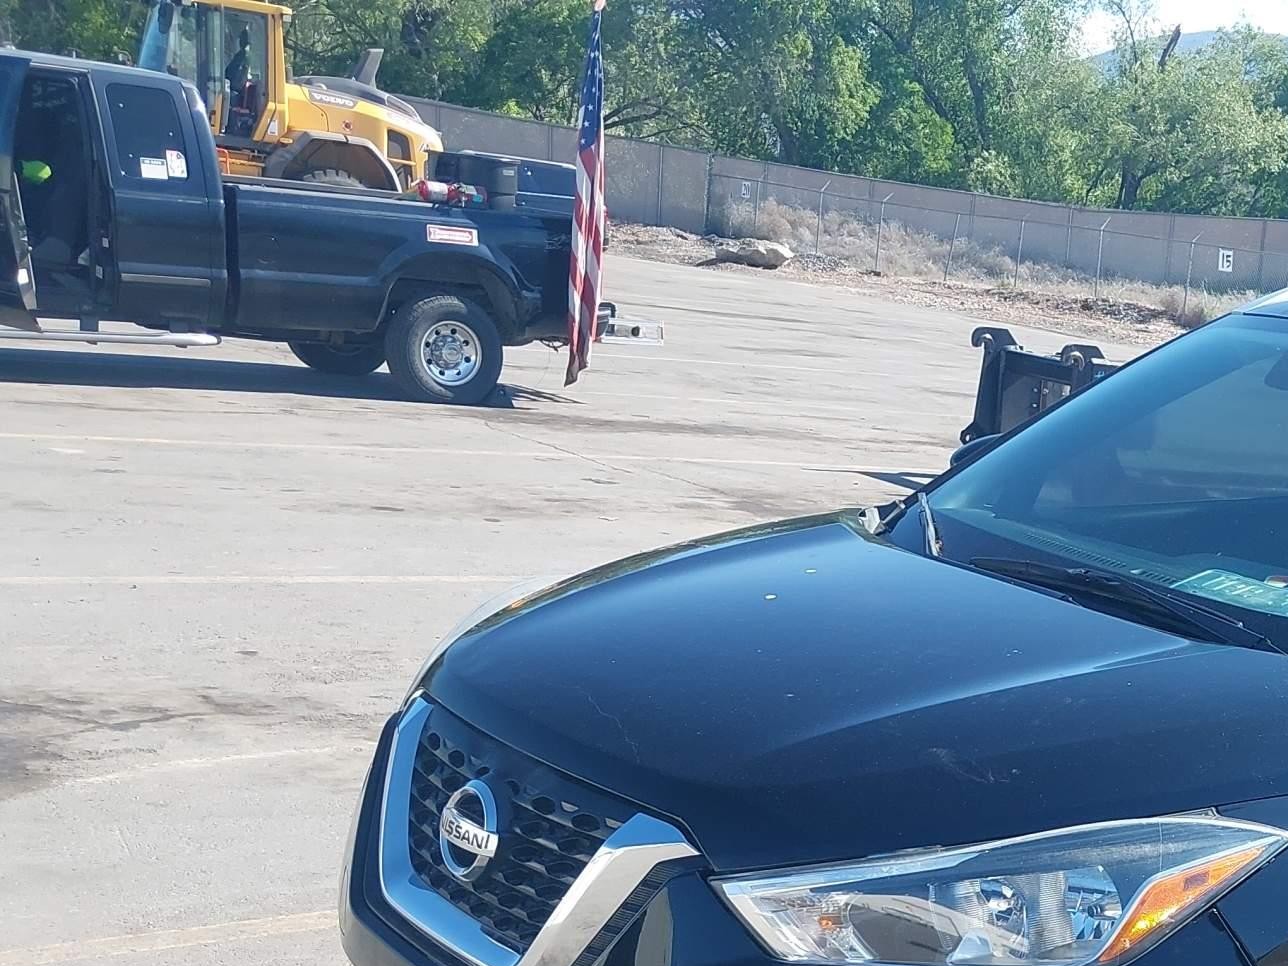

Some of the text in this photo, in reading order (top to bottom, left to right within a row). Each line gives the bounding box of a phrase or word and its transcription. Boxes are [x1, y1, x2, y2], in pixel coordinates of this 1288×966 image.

[313, 92, 354, 107] VOLVO
[1221, 252, 1232, 269] 15
[442, 815, 490, 850] NISSAN
